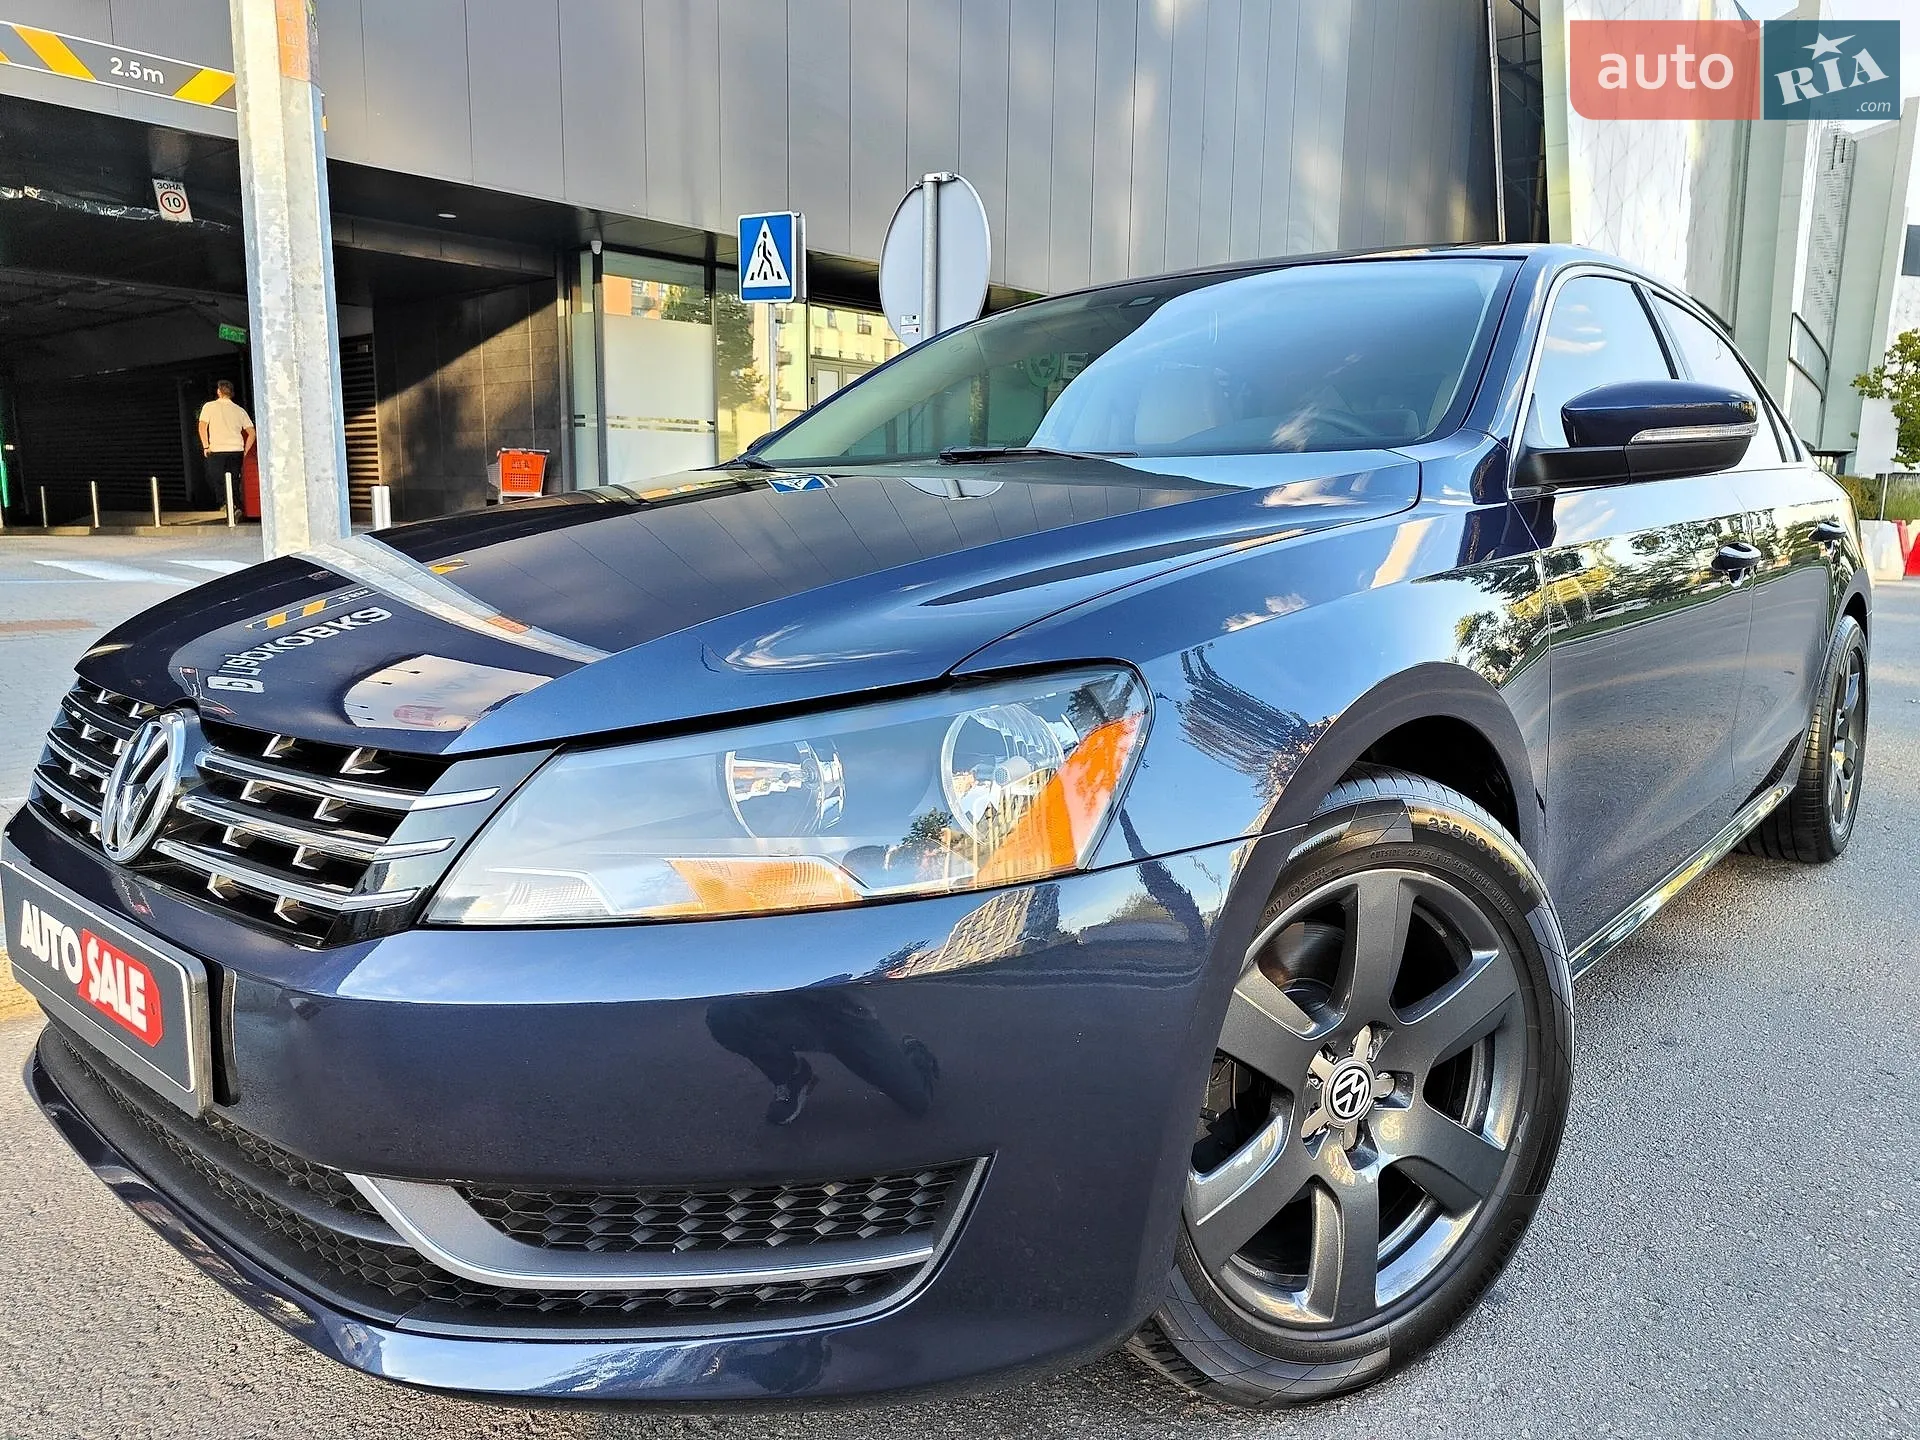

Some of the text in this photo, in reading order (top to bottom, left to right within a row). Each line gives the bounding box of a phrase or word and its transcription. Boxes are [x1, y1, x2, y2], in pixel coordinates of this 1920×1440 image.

[110, 57, 164, 84] 2.5m
[157, 182, 182, 190] ЗОНА
[165, 197, 181, 208] 10
[20, 899, 84, 985] AUTO
